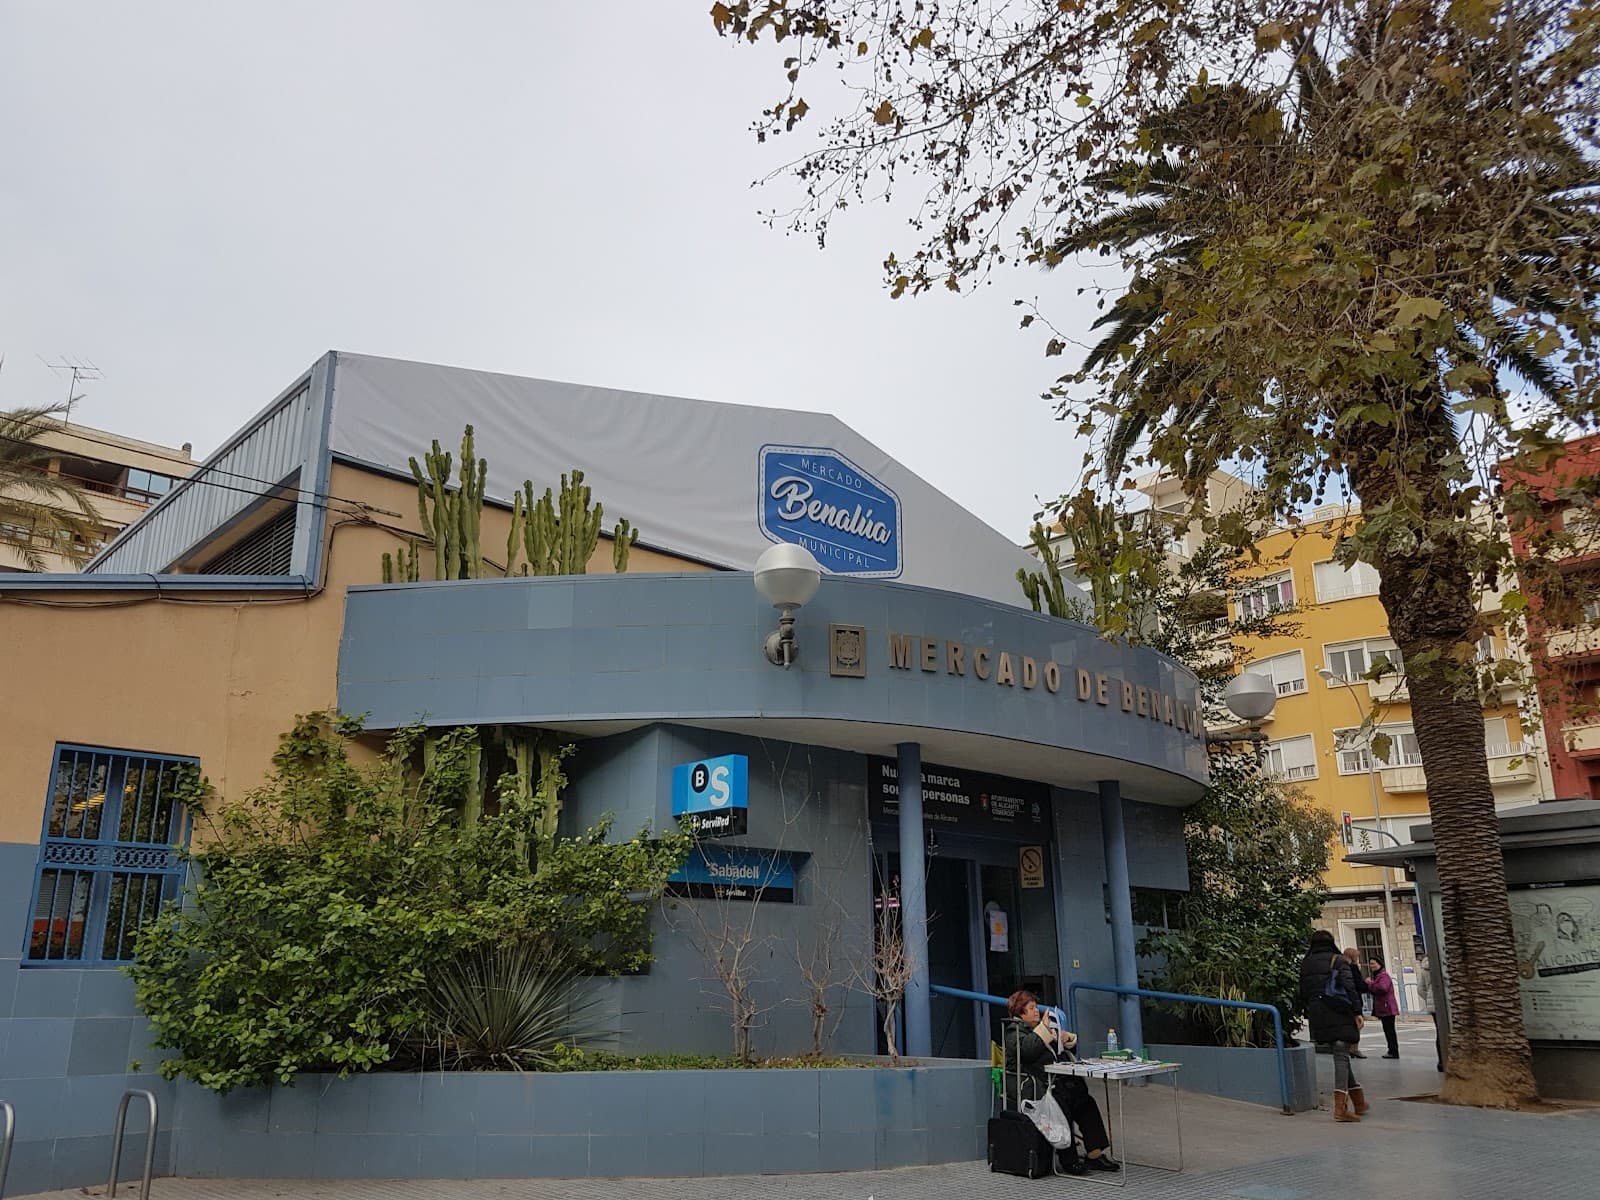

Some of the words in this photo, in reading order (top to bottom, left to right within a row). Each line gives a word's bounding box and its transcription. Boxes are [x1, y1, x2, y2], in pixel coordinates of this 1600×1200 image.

[801, 458, 862, 489] MERCADO
[770, 476, 892, 545] Benalúa
[798, 537, 870, 568] MUNICIPAL
[888, 633, 1062, 693] MERCADO
[1076, 669, 1109, 705] DE
[695, 770, 705, 788] B
[710, 766, 730, 807] S
[922, 789, 970, 805] personas
[927, 775, 961, 788] marca
[709, 863, 760, 880] Sabadell
